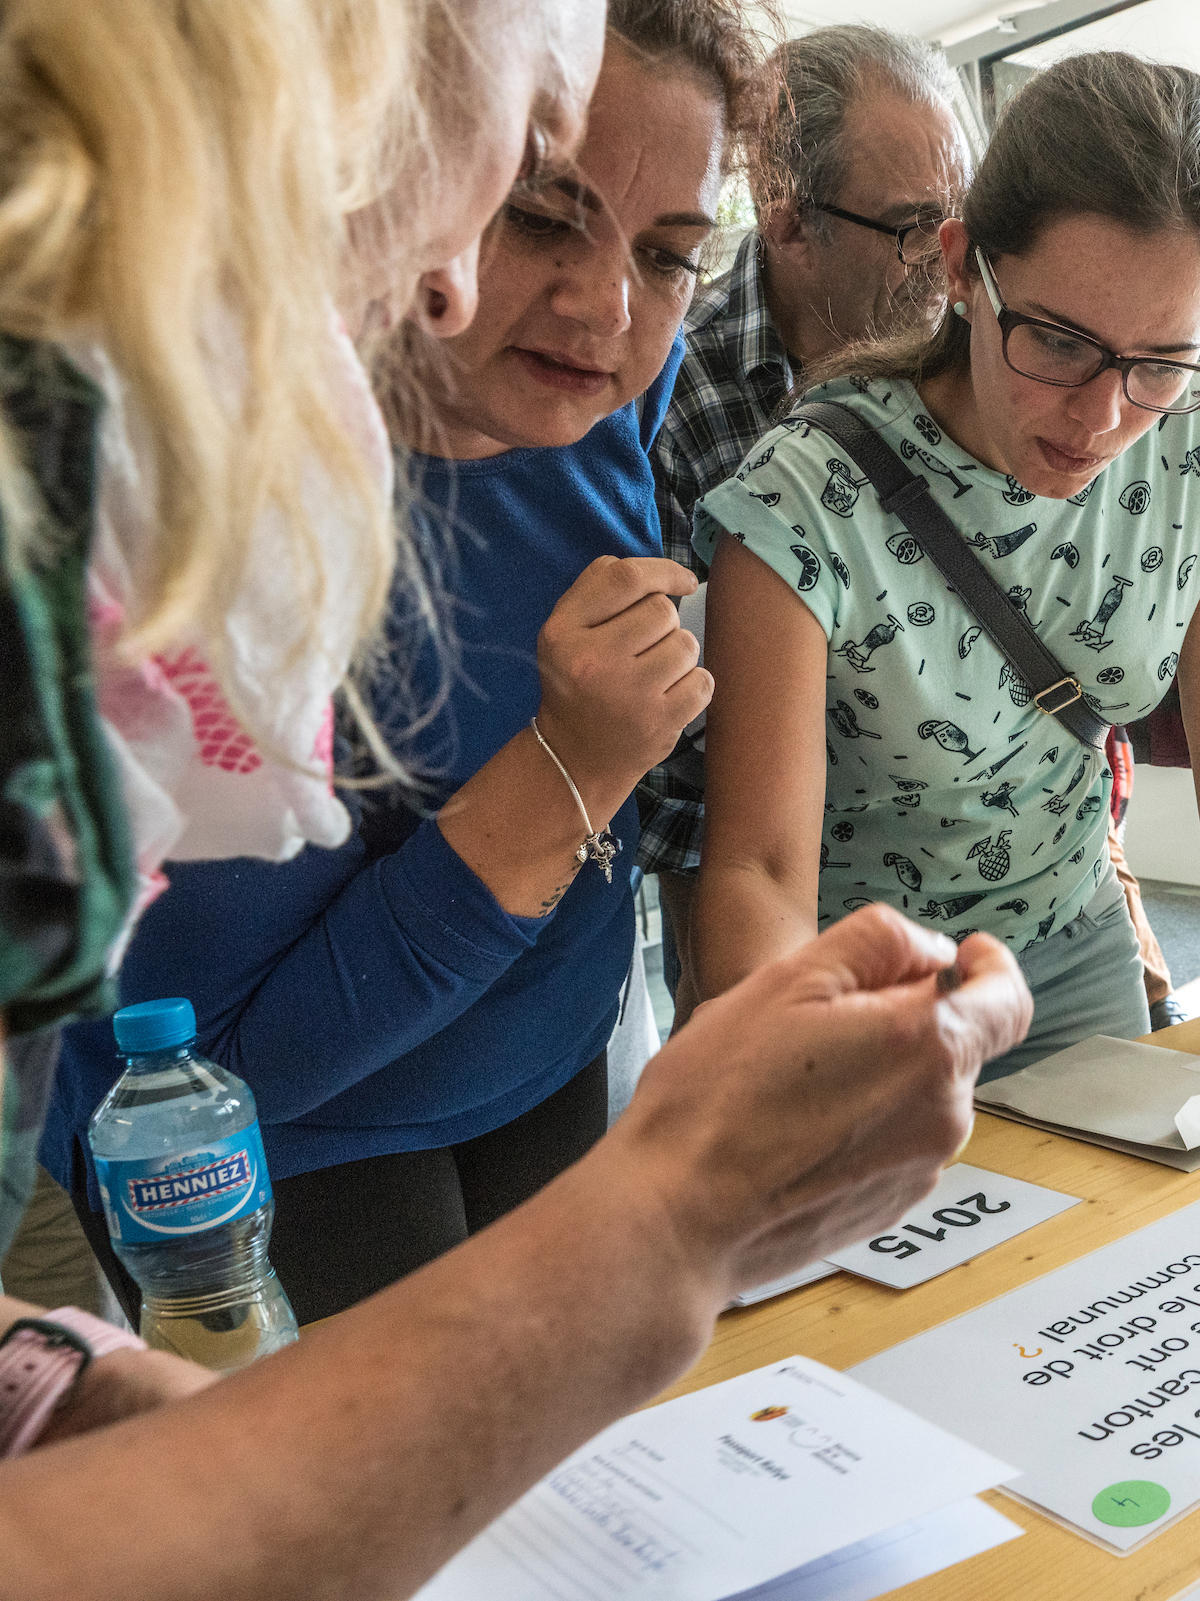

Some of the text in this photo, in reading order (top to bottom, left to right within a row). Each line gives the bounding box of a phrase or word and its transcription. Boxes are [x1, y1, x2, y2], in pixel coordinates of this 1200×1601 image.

[140, 1162, 242, 1202] HENNIEZ
[868, 1192, 1011, 1260] 2015
[1012, 1343, 1043, 1359] ?
[1073, 1316, 1157, 1360] droit
[1125, 1337, 1189, 1372] ont
[1022, 1360, 1075, 1386] de
